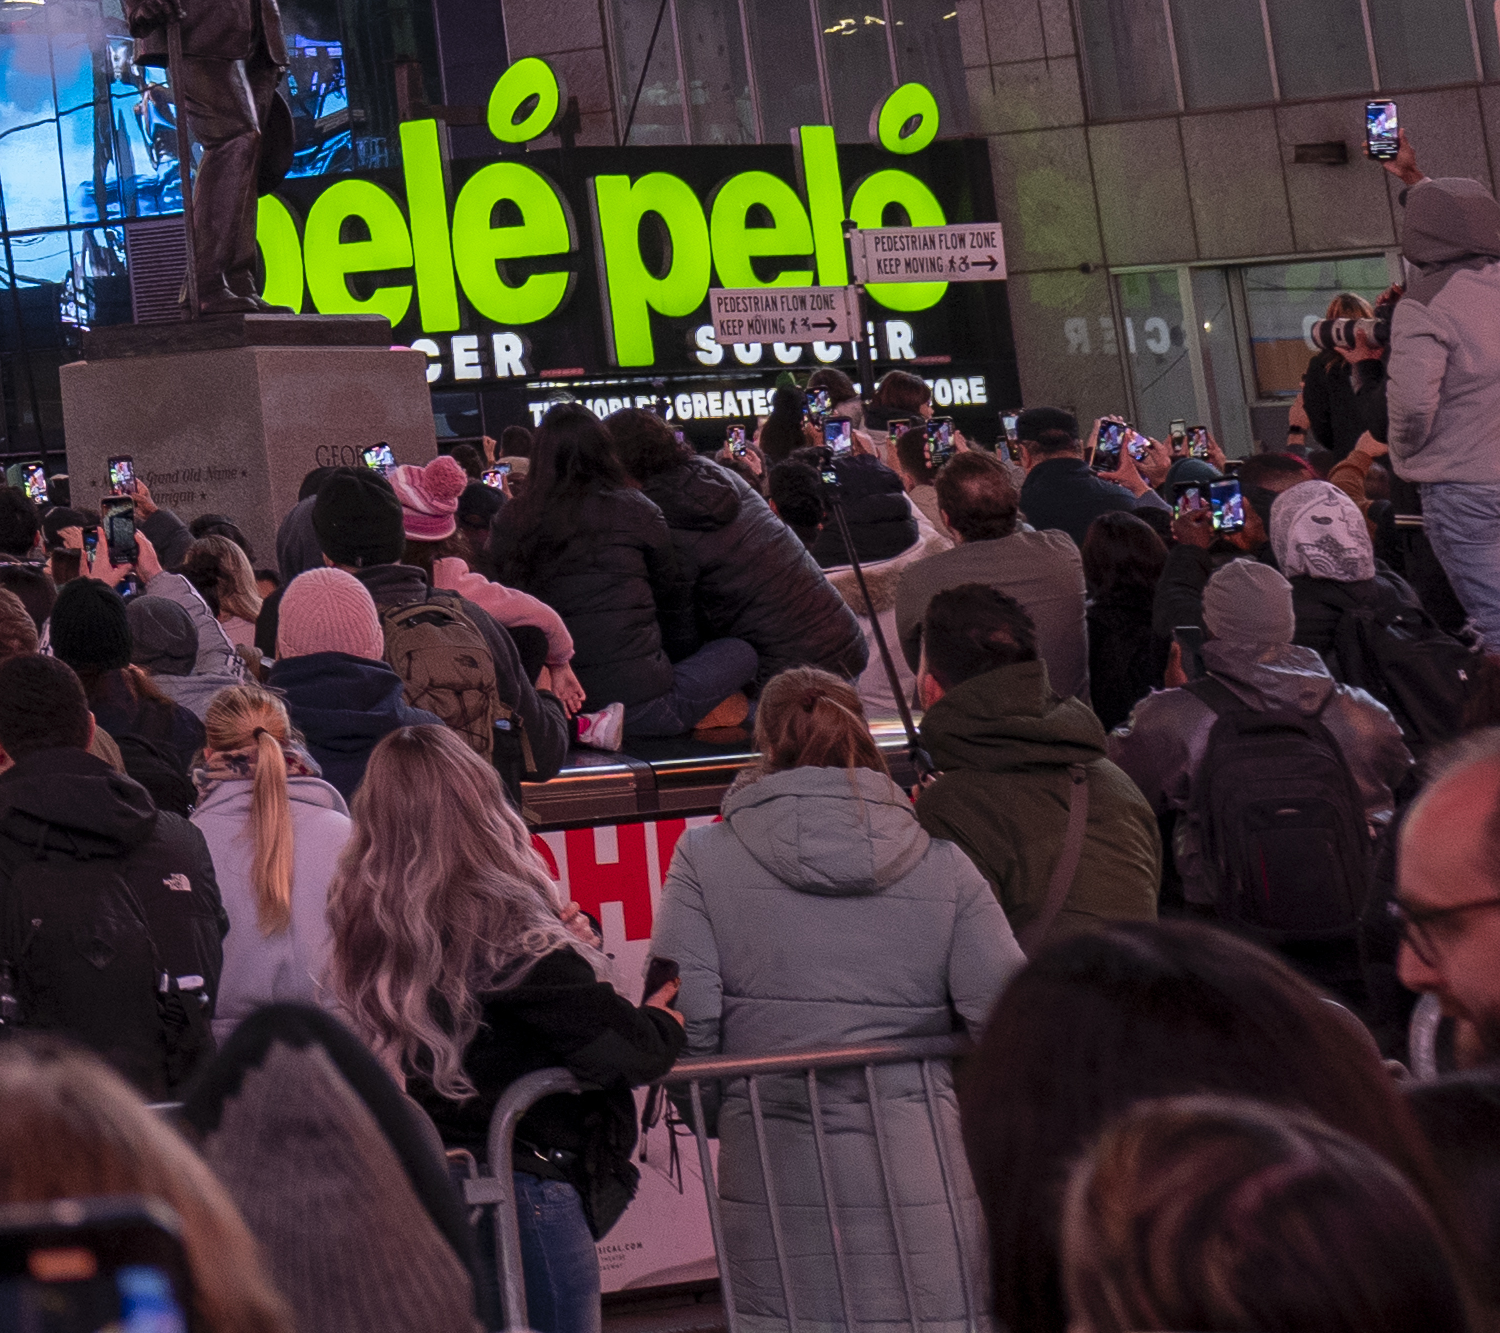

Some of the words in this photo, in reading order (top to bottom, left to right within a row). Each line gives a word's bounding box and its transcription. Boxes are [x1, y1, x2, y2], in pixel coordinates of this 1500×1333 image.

[595, 81, 948, 366] pelé
[874, 233, 936, 252] PEDESTRIAN
[938, 232, 968, 250] FLOW
[969, 231, 998, 249] ZONE
[876, 258, 903, 275] KEEP
[904, 256, 944, 273] MOVING
[717, 295, 778, 313] PEDESTRIAN
[780, 295, 808, 312] FLOW
[809, 293, 836, 311] ZONE
[718, 319, 745, 336] KEEP
[746, 317, 786, 335] MOVING
[182, 468, 203, 484] Old
[205, 467, 238, 483] Name
[152, 490, 197, 508] arrigan
